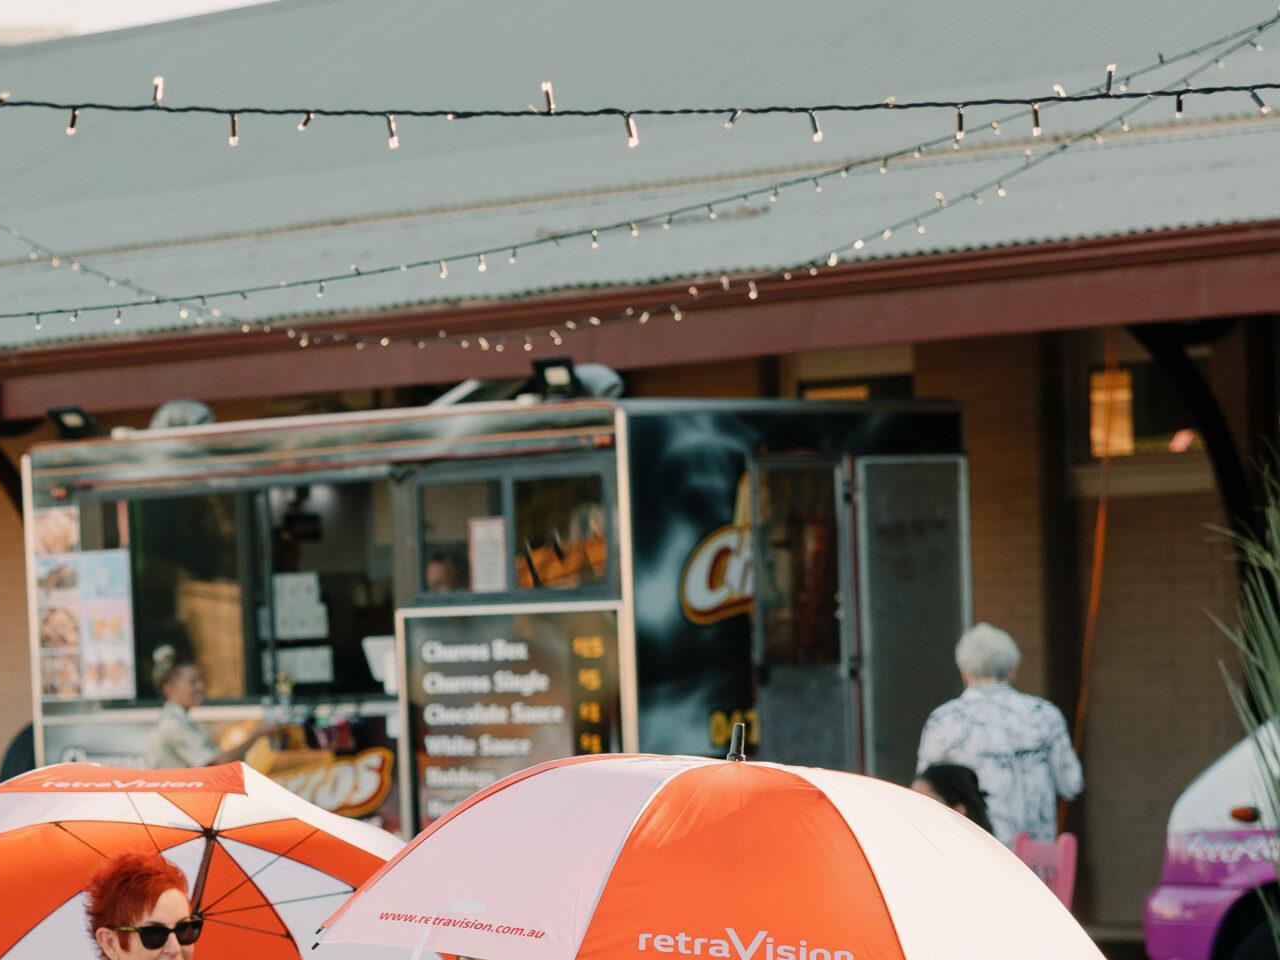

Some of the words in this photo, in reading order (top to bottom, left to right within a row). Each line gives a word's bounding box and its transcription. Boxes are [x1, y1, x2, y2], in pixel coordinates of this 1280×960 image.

[511, 703, 564, 723] Sauce
[479, 735, 531, 755] Sauce
[41, 779, 204, 789] retraVision
[379, 911, 546, 939] www.retravision.com.au
